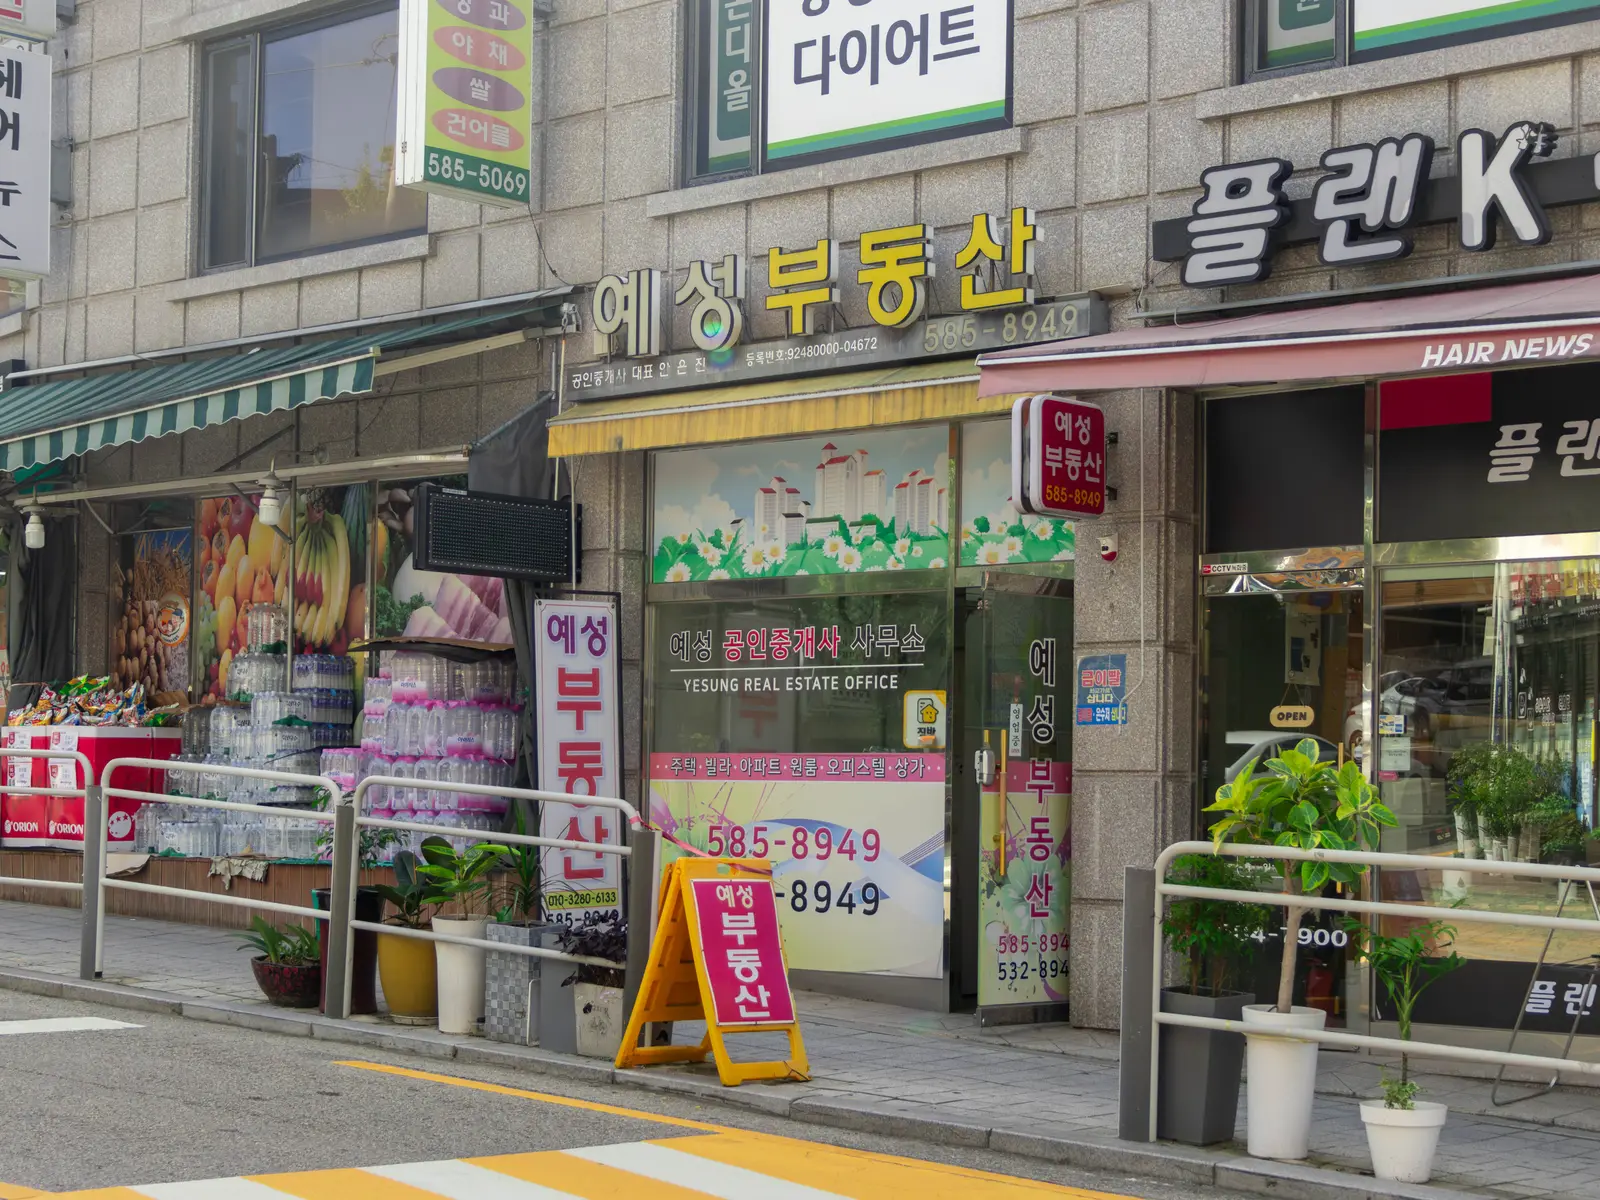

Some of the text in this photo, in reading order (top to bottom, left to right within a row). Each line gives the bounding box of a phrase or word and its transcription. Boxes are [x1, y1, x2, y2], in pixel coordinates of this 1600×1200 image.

[793, 4, 980, 96] 다이어트
[470, 77, 491, 101] 쌀
[447, 112, 510, 148] 건어물
[428, 152, 527, 195] 585-5069
[592, 207, 1040, 357] 예성 부동산
[571, 367, 627, 389] 공인중개사
[632, 363, 653, 380] 대표
[924, 303, 1078, 352] 585-8949
[1421, 333, 1594, 368] HAIR NEWS
[1054, 411, 1091, 445] 예성
[1045, 445, 1102, 483] 부동산
[1046, 485, 1101, 507] 585-8949
[547, 614, 608, 657] 예성
[670, 624, 925, 662] 예성 공인중개사 사무소
[683, 674, 898, 693] YESUNG REAL ESTATE OFFICE
[1082, 669, 1121, 687] 금이빨
[1277, 712, 1307, 721] OPEN
[556, 667, 609, 880] 부동산
[670, 757, 926, 778] 주택 빌라 아파트 원룸 오피스텔 상가
[12, 822, 84, 835] ORION ORION
[707, 825, 881, 862] 585-8949
[548, 892, 617, 906] 010-3280-6133
[716, 885, 753, 909] 예성
[721, 912, 771, 1018] 부동산
[1525, 980, 1597, 1015] 플랜
